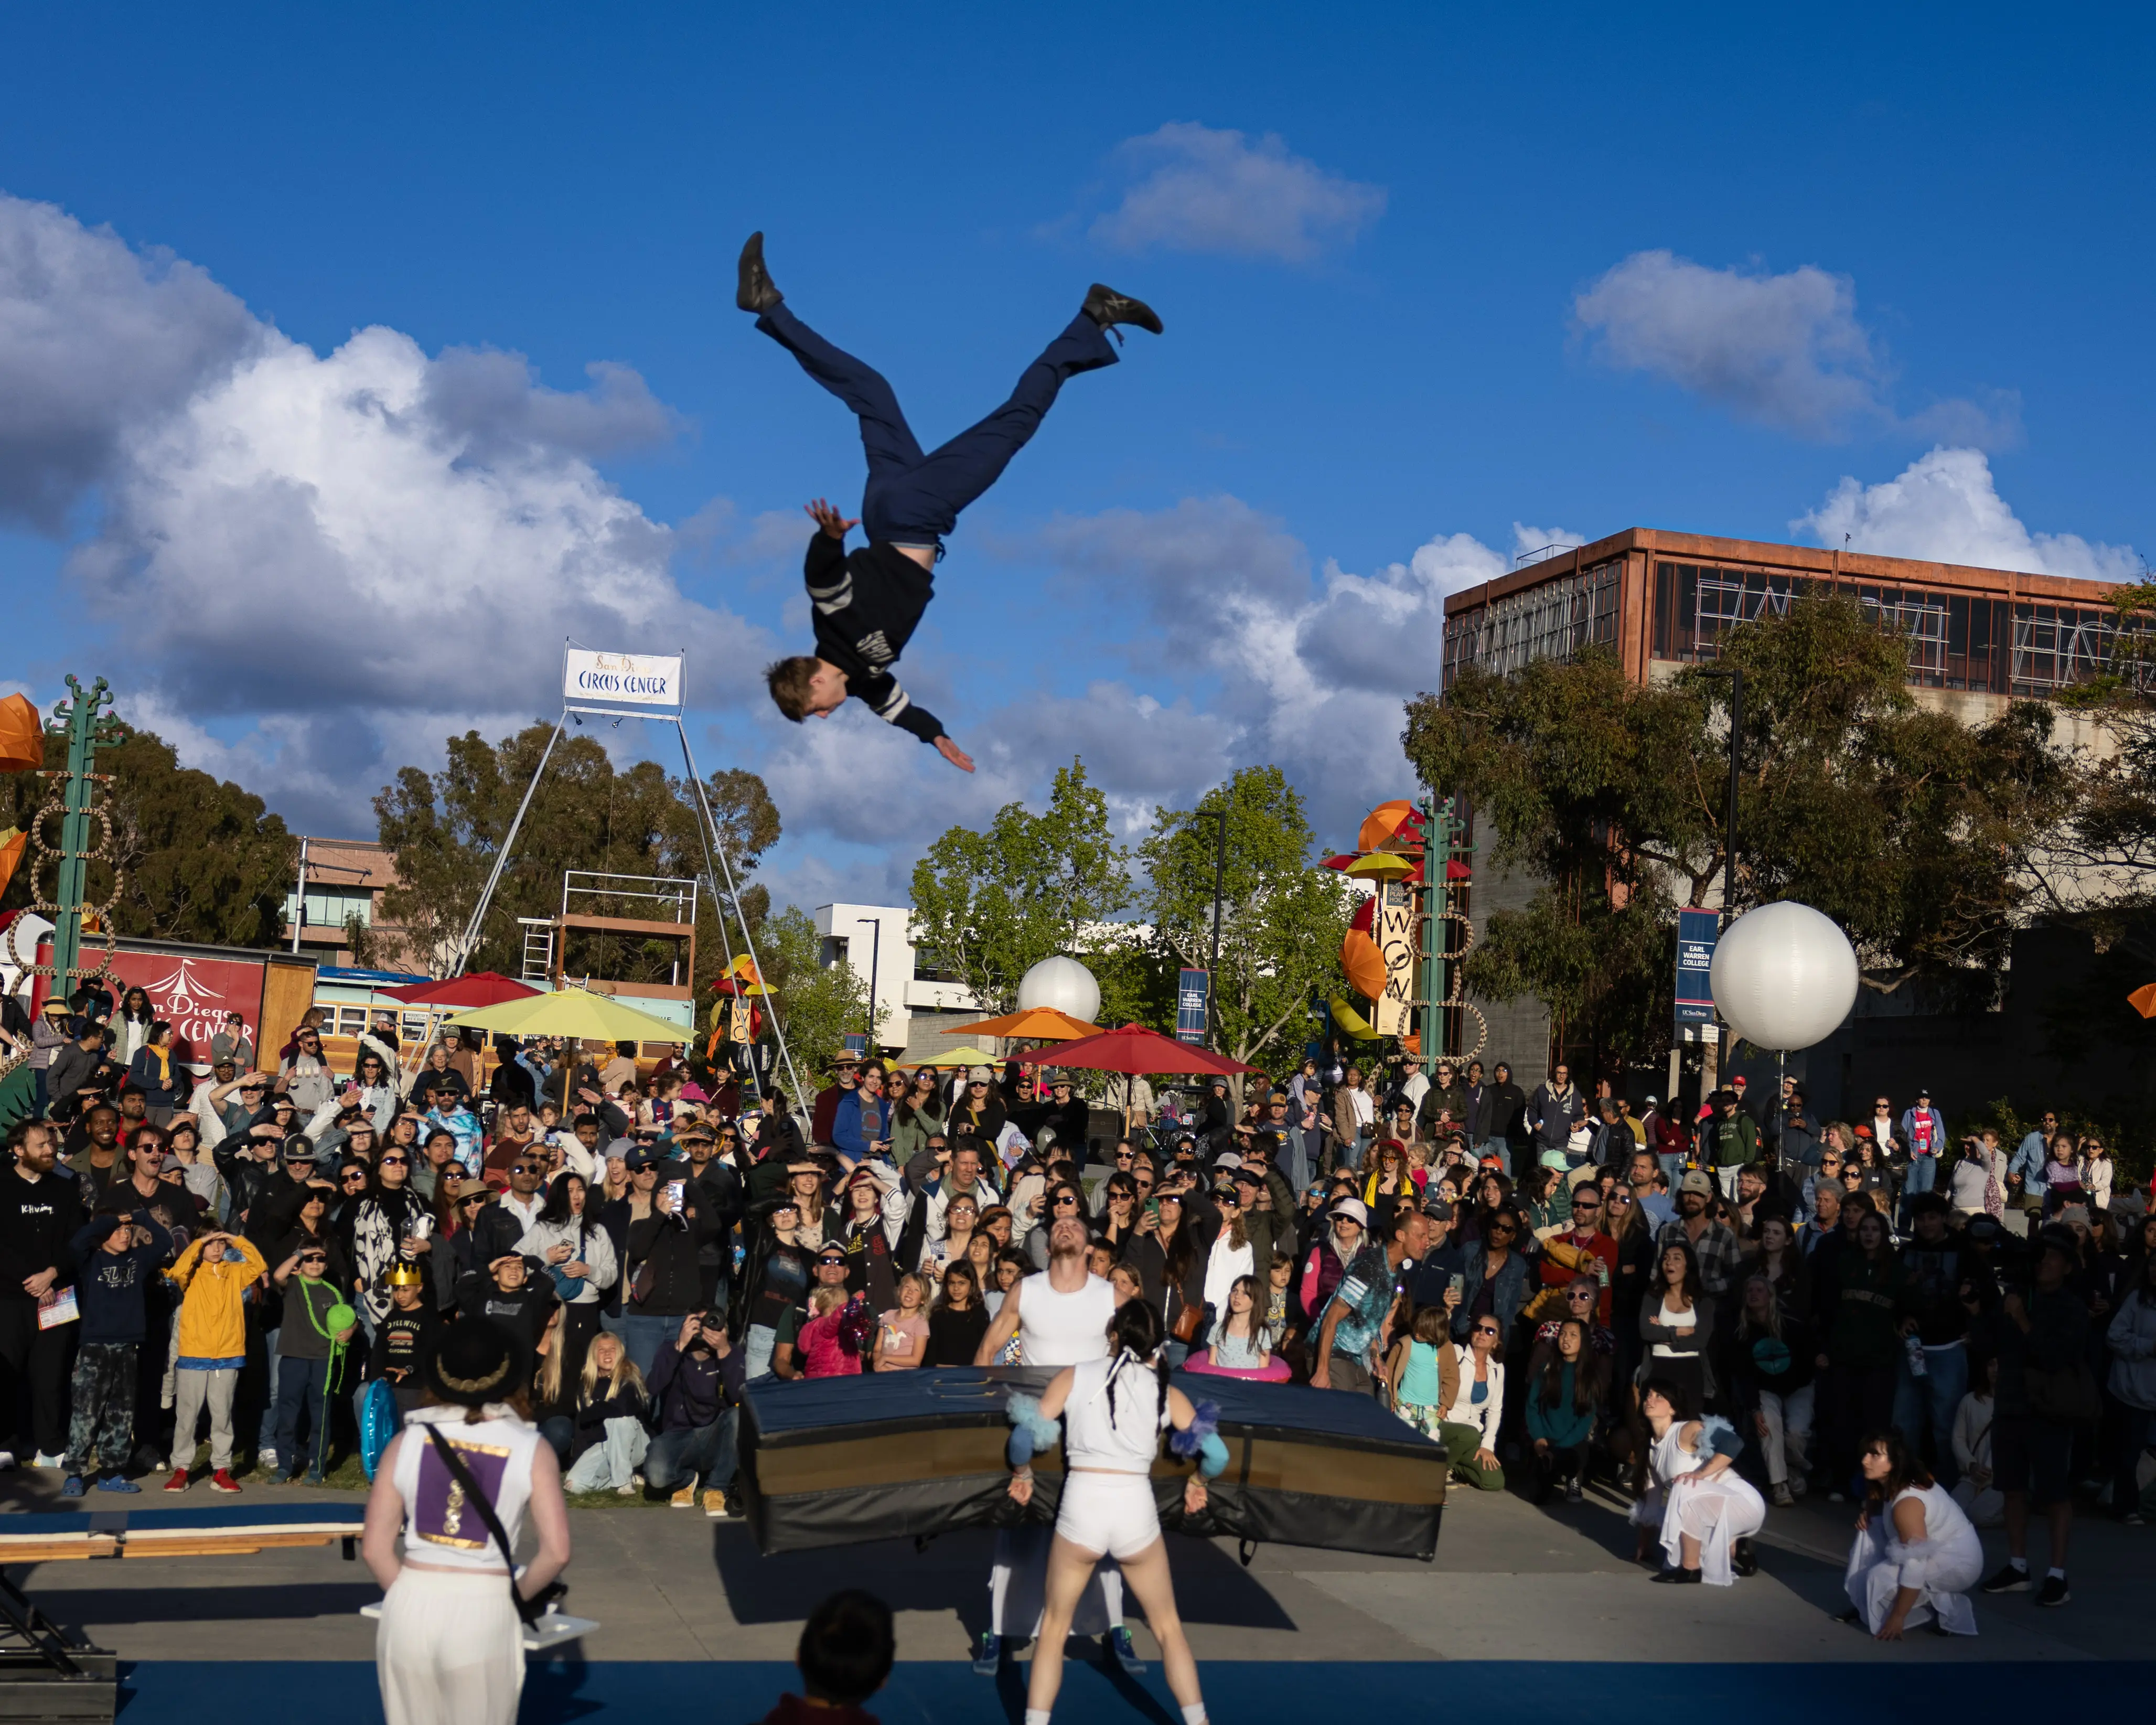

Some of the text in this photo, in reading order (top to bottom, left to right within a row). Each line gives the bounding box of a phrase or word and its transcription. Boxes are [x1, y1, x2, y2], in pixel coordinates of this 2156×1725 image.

[595, 655, 618, 670] San
[579, 670, 666, 694] CIRCUS CENTER
[1383, 910, 1412, 999] WOW
[167, 993, 233, 1023] Diego
[179, 1018, 253, 1046] CENTR
[734, 1011, 749, 1041] WO
